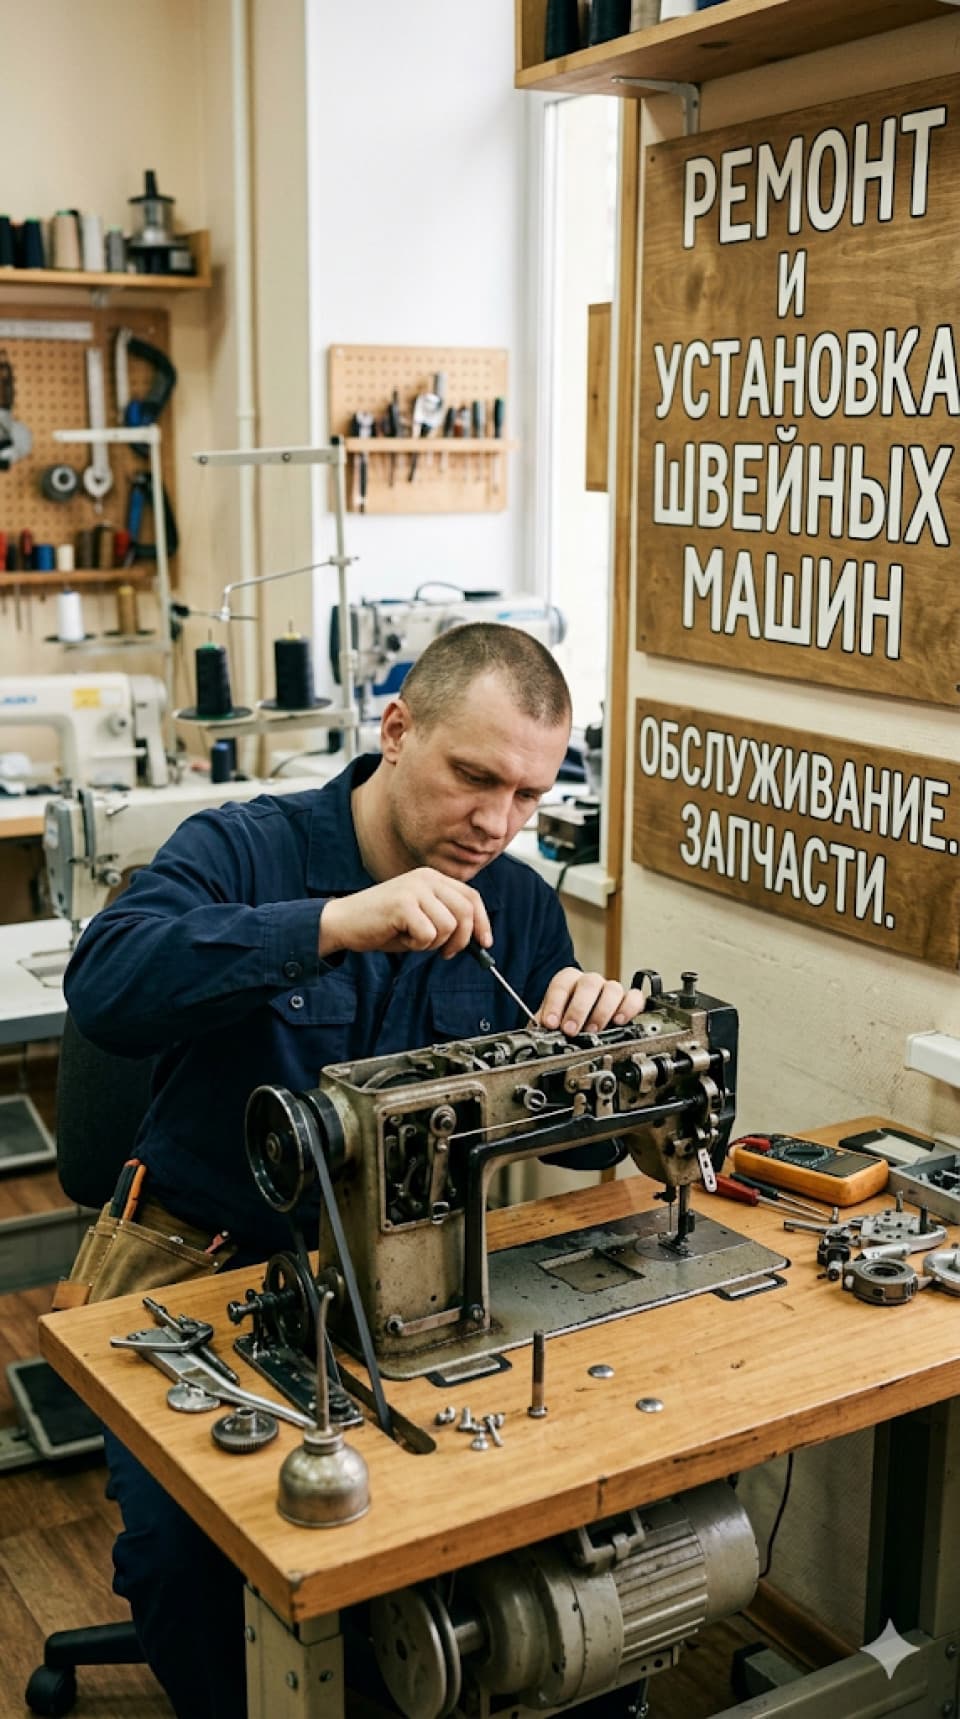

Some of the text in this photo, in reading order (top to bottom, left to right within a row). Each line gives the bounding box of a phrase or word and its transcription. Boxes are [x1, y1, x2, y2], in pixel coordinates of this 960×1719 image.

[683, 107, 947, 249] РЕМОНТ
[777, 250, 807, 318] И
[653, 326, 960, 419] УСТАНОВКА
[653, 425, 953, 546] ШВЕЙНЫХ
[682, 545, 903, 660] МАШИН
[639, 716, 959, 855] ОБСЛУЖИВАНИЕ.
[679, 802, 895, 929] ЗАПЧАСТИ.
